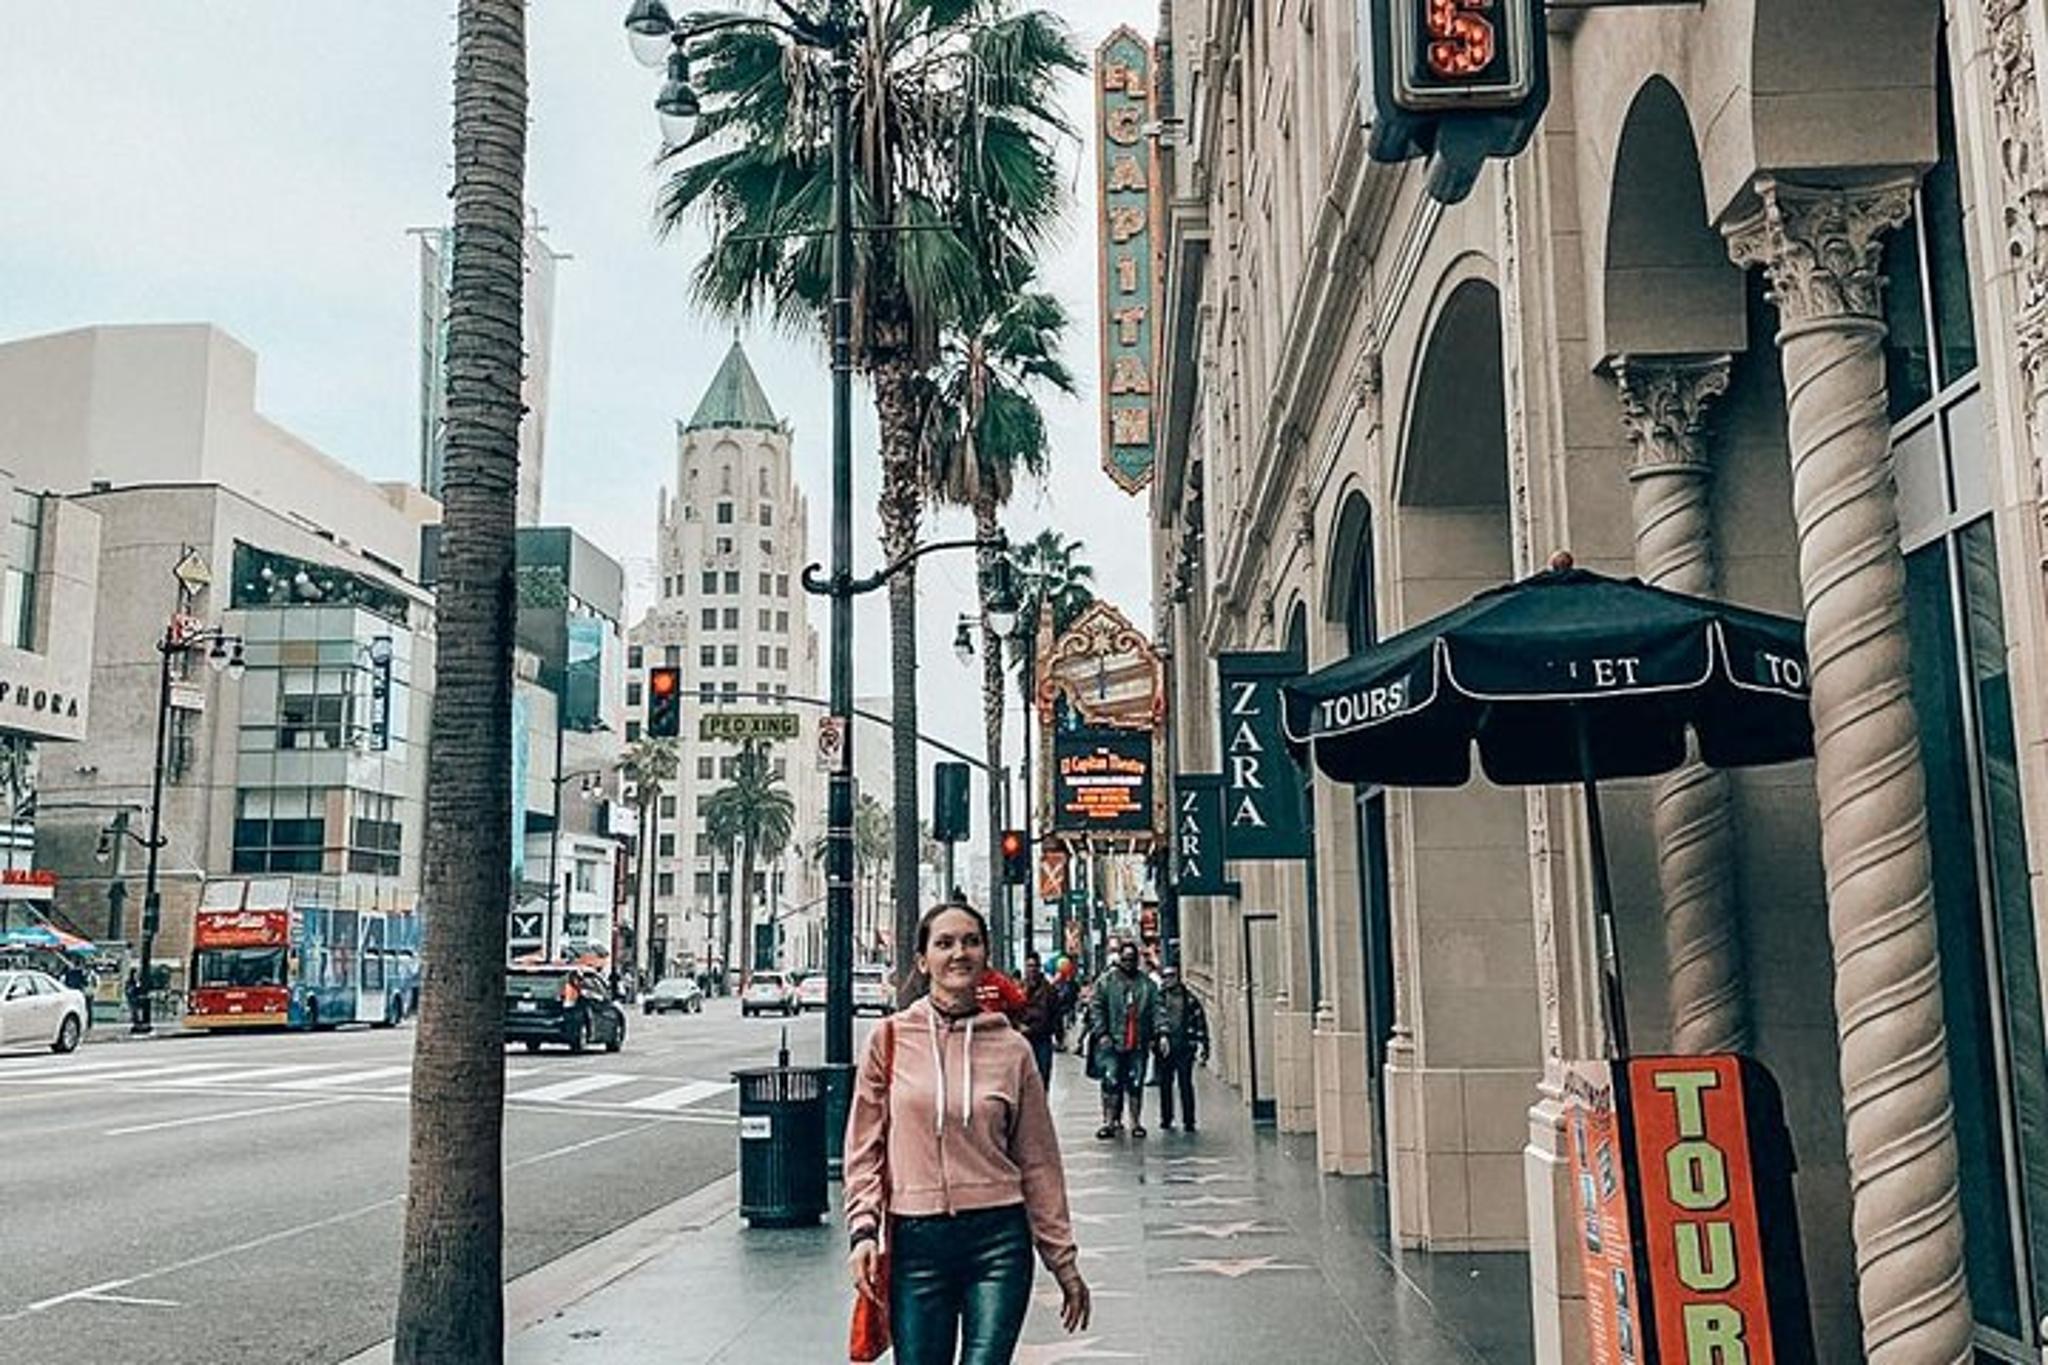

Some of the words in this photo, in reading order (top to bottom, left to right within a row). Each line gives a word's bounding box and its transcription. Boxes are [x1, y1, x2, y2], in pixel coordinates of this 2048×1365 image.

[1104, 63, 1147, 98] EL
[1106, 106, 1152, 445] CAPITAN
[752, 718, 792, 732] XING
[1321, 682, 1403, 728] TOURS
[1229, 682, 1267, 827] ZARA
[1180, 790, 1201, 877] ZARA
[1653, 1070, 1748, 1365] TOUR
